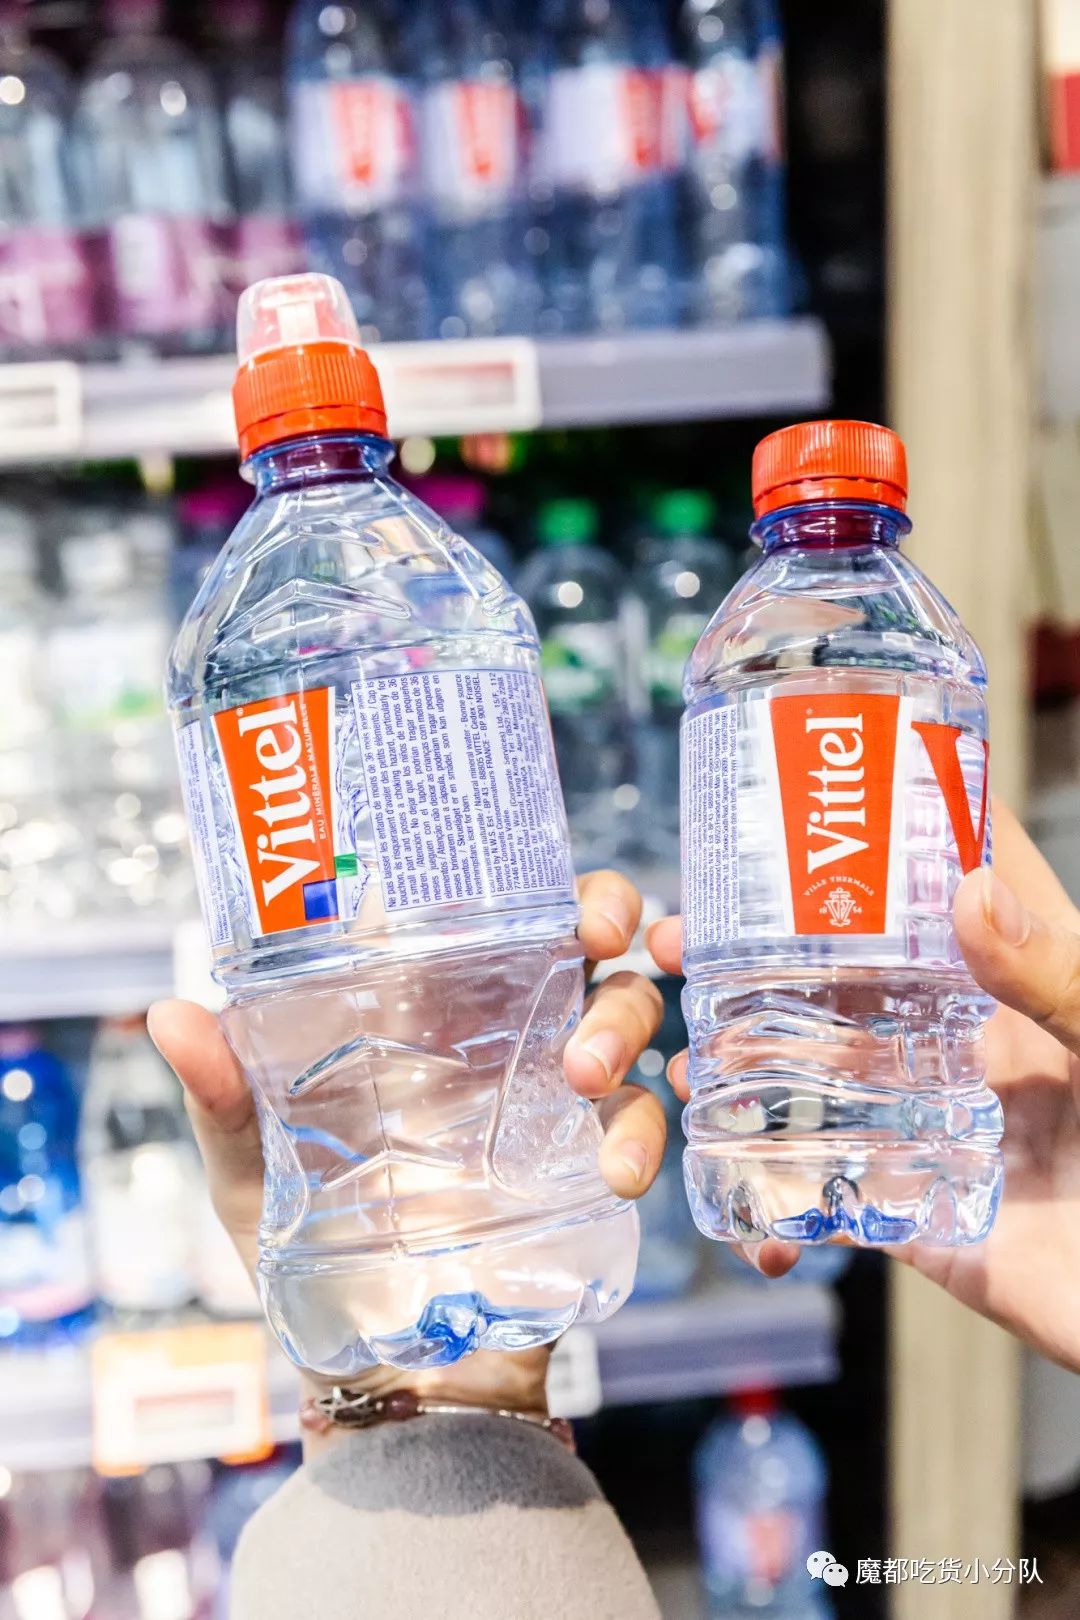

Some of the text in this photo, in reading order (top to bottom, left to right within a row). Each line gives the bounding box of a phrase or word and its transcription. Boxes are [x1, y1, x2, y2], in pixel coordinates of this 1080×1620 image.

[377, 680, 385, 690] for
[387, 678, 397, 688] 36
[409, 675, 419, 685] 36
[432, 674, 440, 684] en
[454, 673, 464, 698] source
[464, 674, 473, 700] France
[488, 672, 497, 686] 112
[367, 689, 377, 704] Cap
[390, 691, 399, 700] de
[399, 676, 413, 713] pequeños
[412, 687, 421, 696] de
[421, 674, 434, 710] pequenos
[379, 694, 395, 735] particularly
[393, 703, 403, 728] menos
[414, 697, 424, 722] menos
[458, 699, 468, 722] Bonne
[476, 704, 486, 719] 900
[500, 696, 509, 715] 2805
[427, 713, 437, 734] tragar
[438, 715, 447, 729] kan
[469, 706, 478, 729] Cedex
[479, 720, 487, 730] BP
[396, 730, 405, 740] de
[406, 718, 417, 741] tragar
[418, 723, 427, 740] com
[463, 729, 472, 750] water
[441, 732, 450, 748] som
[471, 731, 482, 755] VITTEL
[364, 751, 374, 762] 36
[376, 747, 387, 768] petits
[398, 742, 408, 763] niños
[421, 741, 432, 772] crianças
[431, 737, 444, 771] poderiam
[481, 739, 493, 768] FRANCE
[366, 764, 376, 773] de
[402, 765, 411, 776] los
[465, 751, 477, 778] mineral
[369, 775, 380, 798] moins
[379, 770, 389, 784] des
[391, 769, 403, 799] choking
[404, 779, 414, 793] que
[426, 773, 434, 782] as
[514, 777, 522, 796] Hong
[415, 779, 426, 803] tapón,
[427, 784, 438, 806] deixar
[449, 783, 457, 793] en
[481, 786, 489, 796] 43
[504, 768, 517, 807] (Corporate
[805, 713, 870, 874] Vittel
[239, 700, 320, 907] Vittel
[372, 800, 382, 810] de
[406, 796, 417, 815] dejar
[451, 796, 459, 804] er
[482, 798, 491, 808] BP
[488, 770, 503, 829] Consommateurs
[911, 721, 989, 876] V
[398, 811, 410, 834] poses
[410, 817, 419, 828] No
[430, 807, 440, 821] não
[443, 814, 452, 830] com
[463, 813, 472, 823] for
[485, 815, 494, 827] Est
[318, 819, 327, 840] EAU
[374, 811, 386, 839] enfants
[422, 820, 431, 835] con
[466, 825, 474, 841] især
[476, 812, 488, 844] naturelle
[379, 841, 388, 853] les
[386, 816, 401, 859] risqueraient
[401, 837, 411, 851] and
[516, 835, 523, 845] by
[521, 828, 530, 848] Road
[530, 834, 538, 843] DE
[425, 839, 438, 870] jueguen
[446, 833, 459, 870] brincarem
[503, 807, 521, 889] 77446 Marne la Vallée.
[381, 855, 392, 879] laisser
[404, 855, 416, 871] part
[493, 855, 500, 864] by
[517, 848, 530, 889] Distributed
[385, 880, 396, 894] pas
[407, 874, 418, 895] small
[440, 861, 452, 899] elementos
[453, 872, 463, 897] meses
[493, 865, 504, 892] Bottled
[503, 863, 513, 891] Service
[829, 876, 875, 896] THERMALE
[396, 871, 408, 906] bouchon,
[431, 875, 442, 900] meses
[387, 896, 396, 907] Ne
